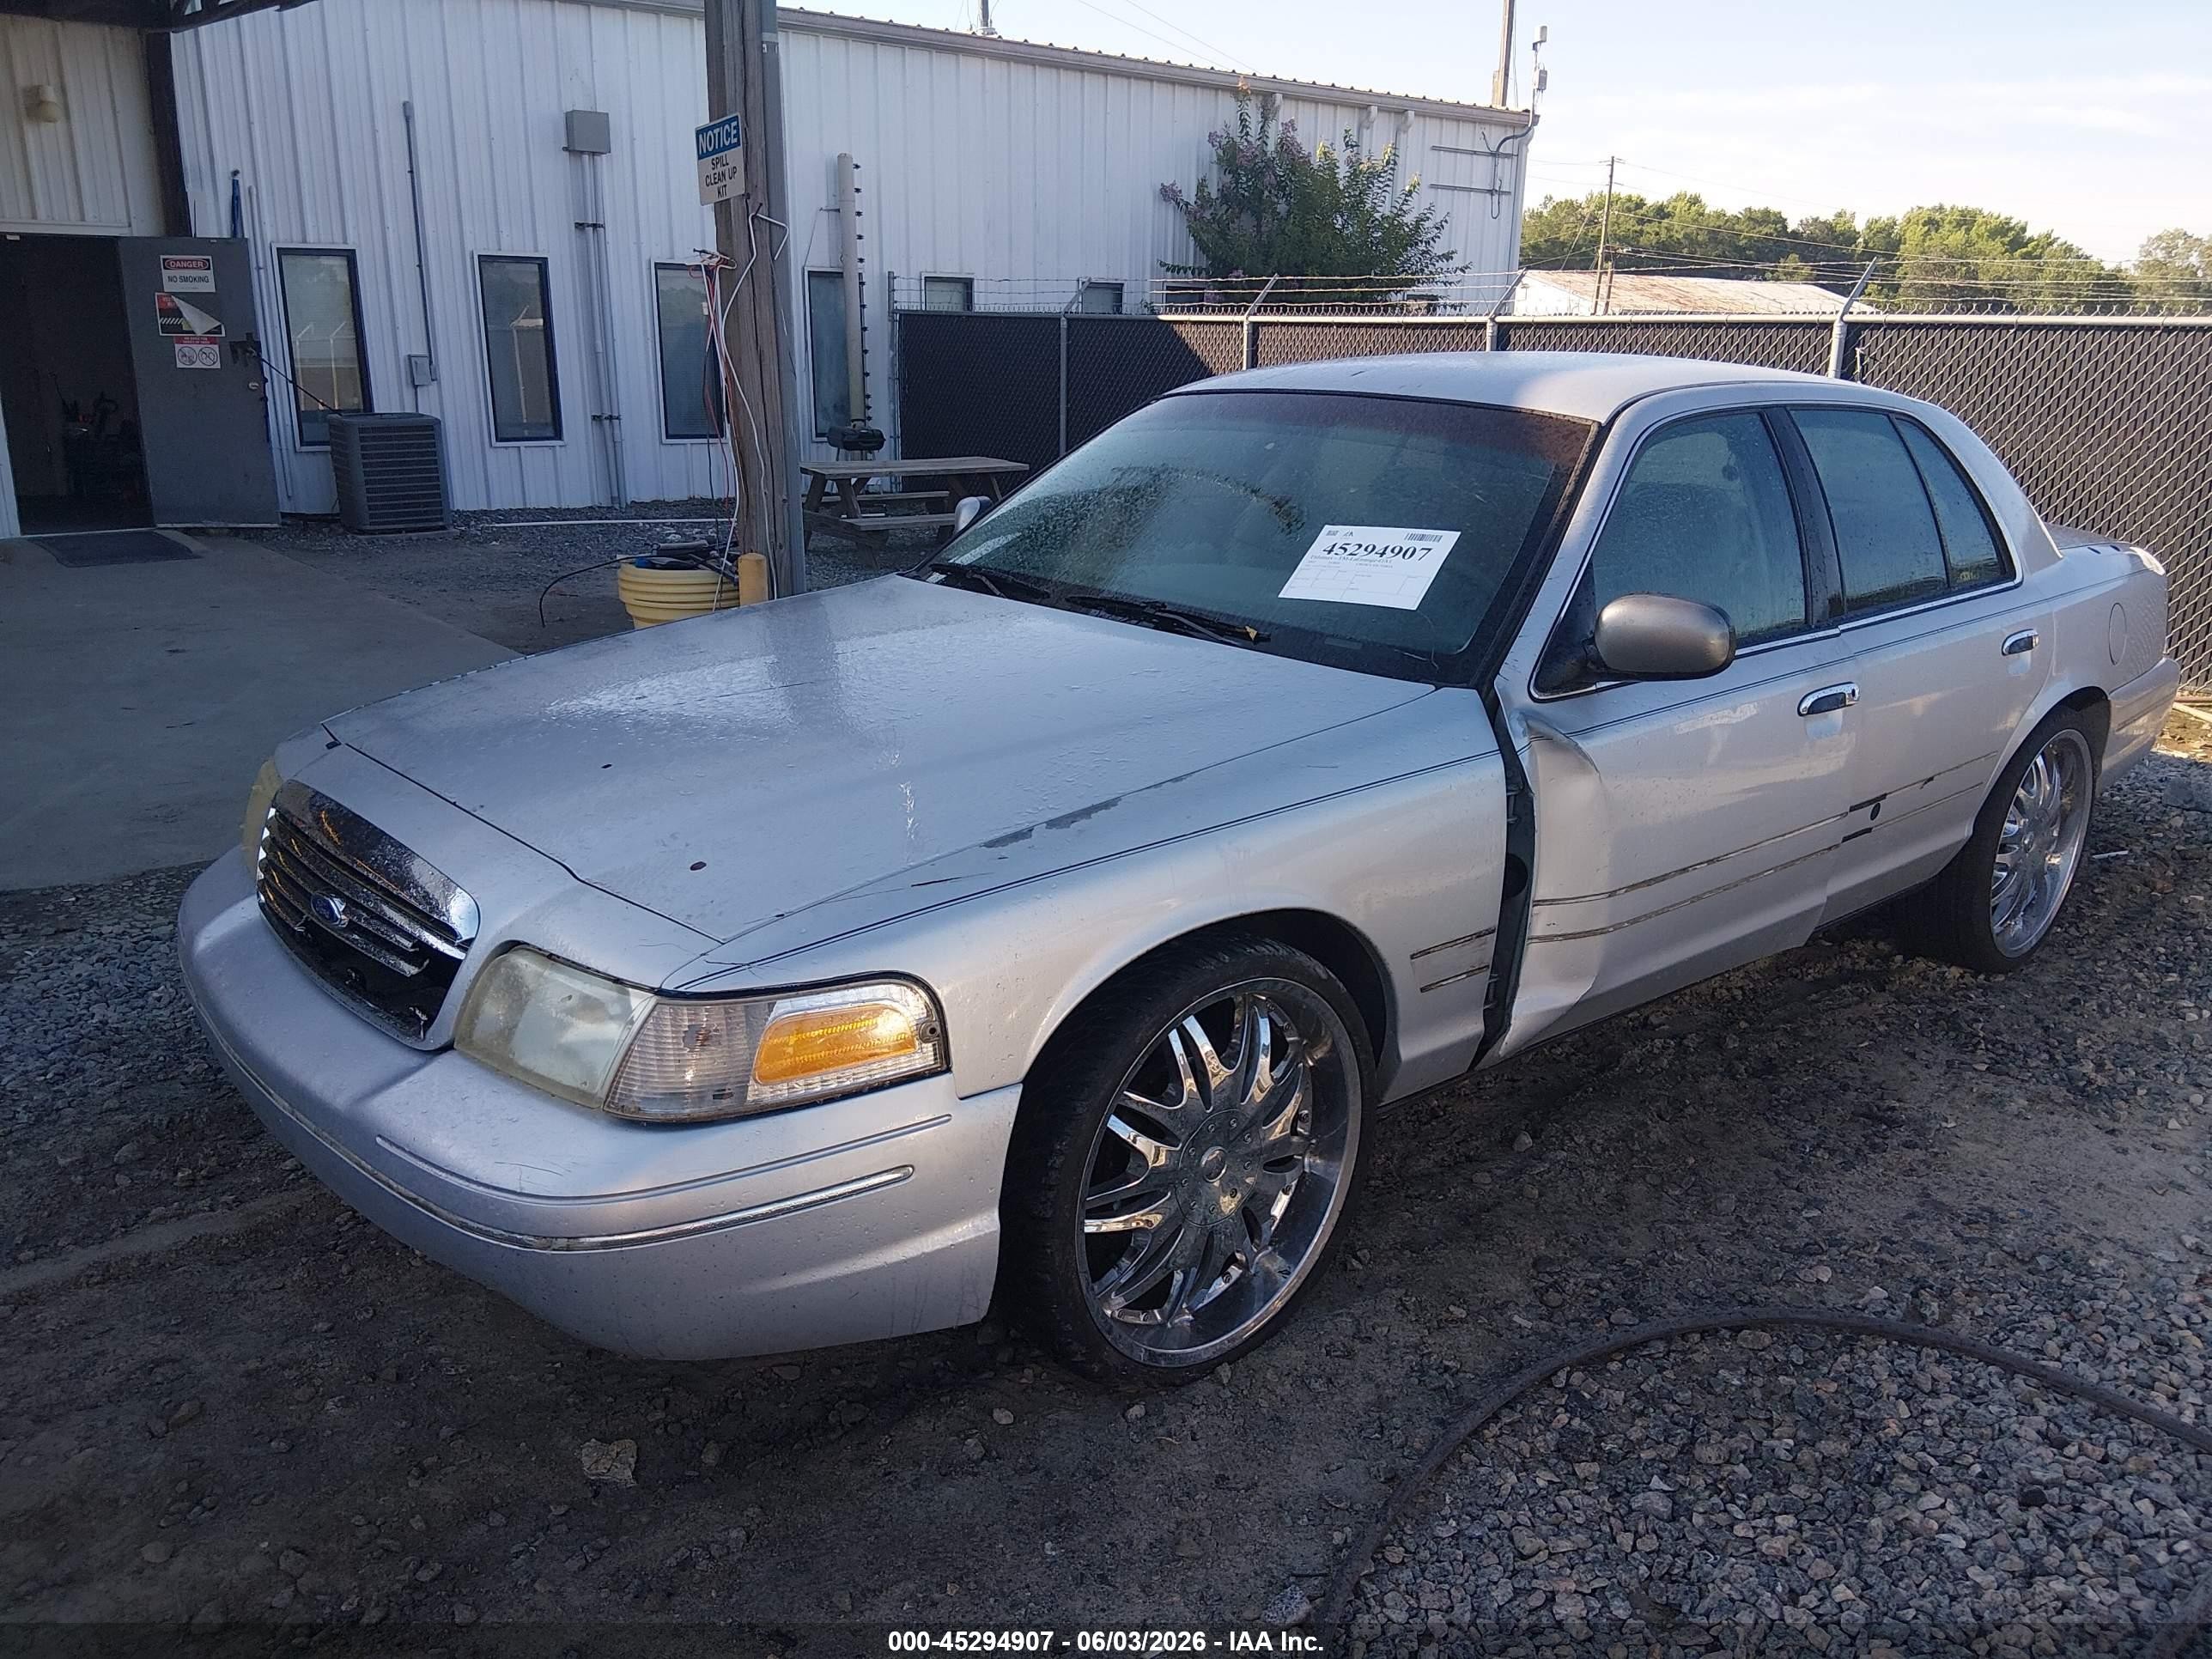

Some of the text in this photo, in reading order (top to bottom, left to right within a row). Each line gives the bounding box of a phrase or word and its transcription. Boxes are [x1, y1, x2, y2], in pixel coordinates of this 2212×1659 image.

[699, 121, 738, 154] NOTICE
[711, 154, 729, 171] SPILL
[705, 167, 738, 187] CLEAN UP
[717, 185, 727, 198] KIT
[1322, 543, 1432, 562] 45294907
